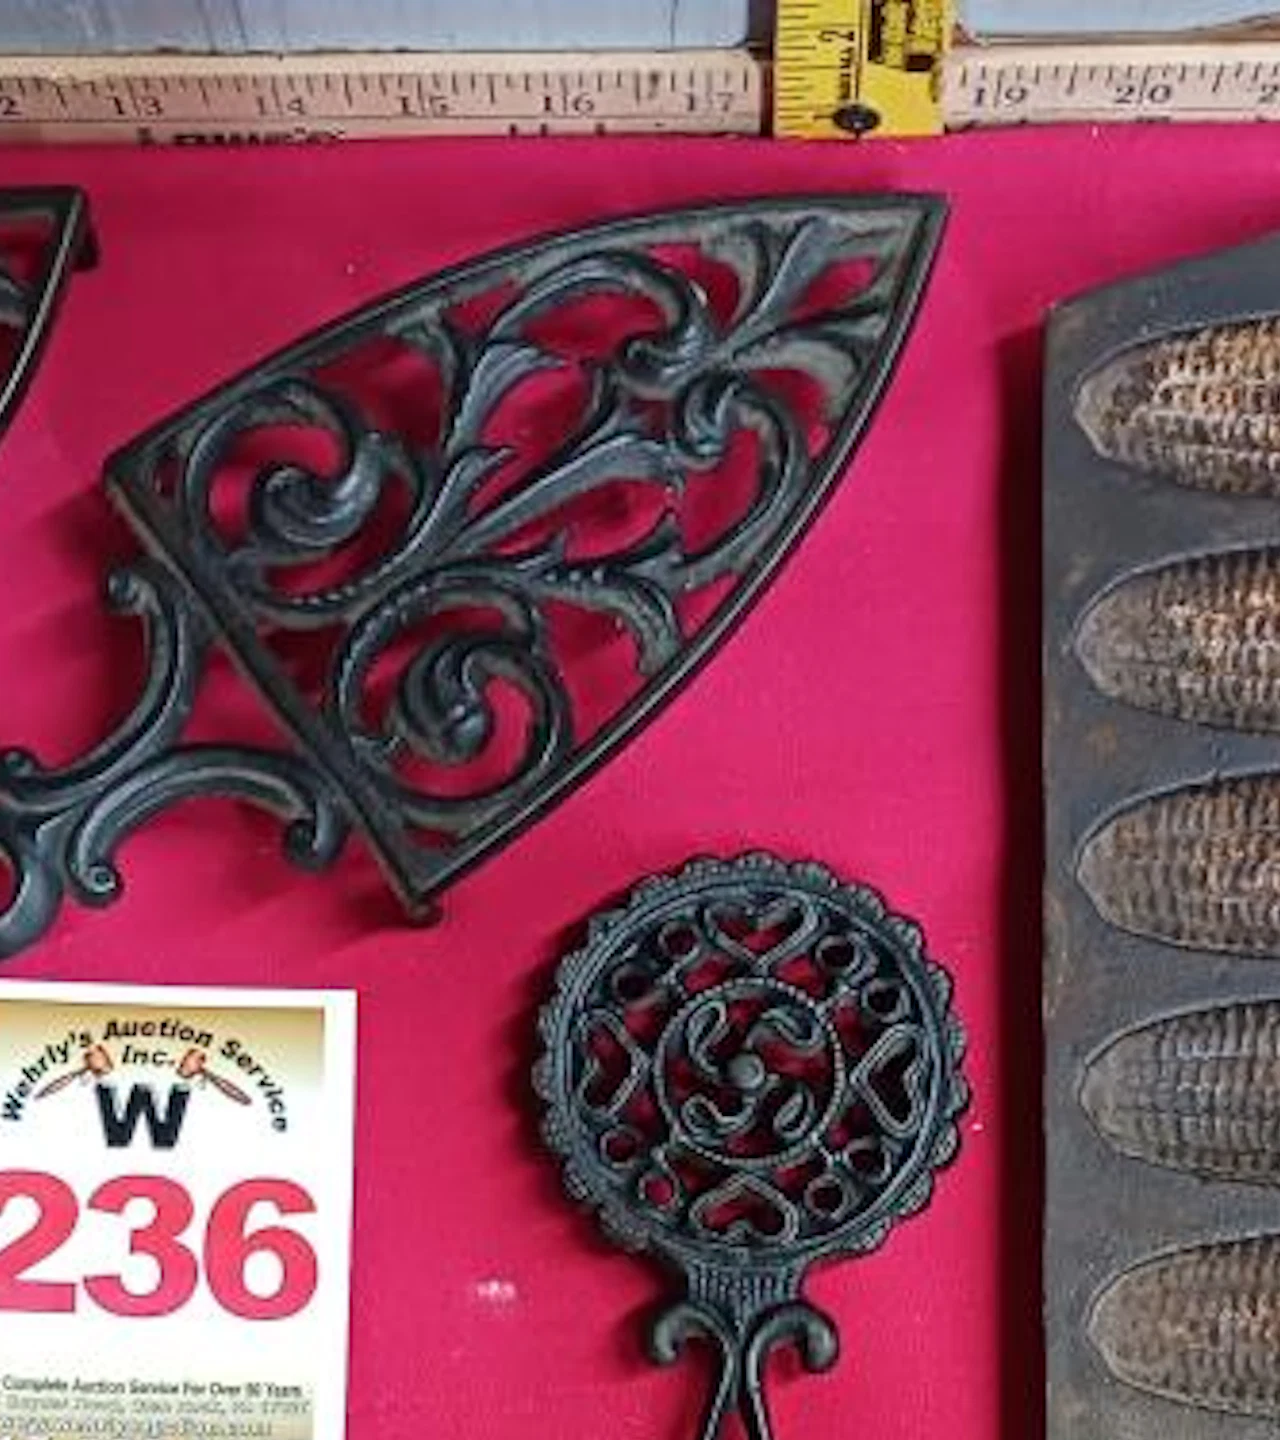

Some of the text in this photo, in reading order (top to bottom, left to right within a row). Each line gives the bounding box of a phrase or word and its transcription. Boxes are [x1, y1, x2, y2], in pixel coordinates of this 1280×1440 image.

[110, 95, 165, 116] 13
[122, 1044, 175, 1066] Inc.
[0, 1018, 289, 1133] Wehrly's Auction Service
[95, 1082, 192, 1150] W
[2, 1375, 68, 1394] Complete
[72, 1378, 126, 1395] Auction
[129, 1379, 179, 1396] Service
[209, 1382, 241, 1397] Over
[266, 1382, 303, 1399] Years
